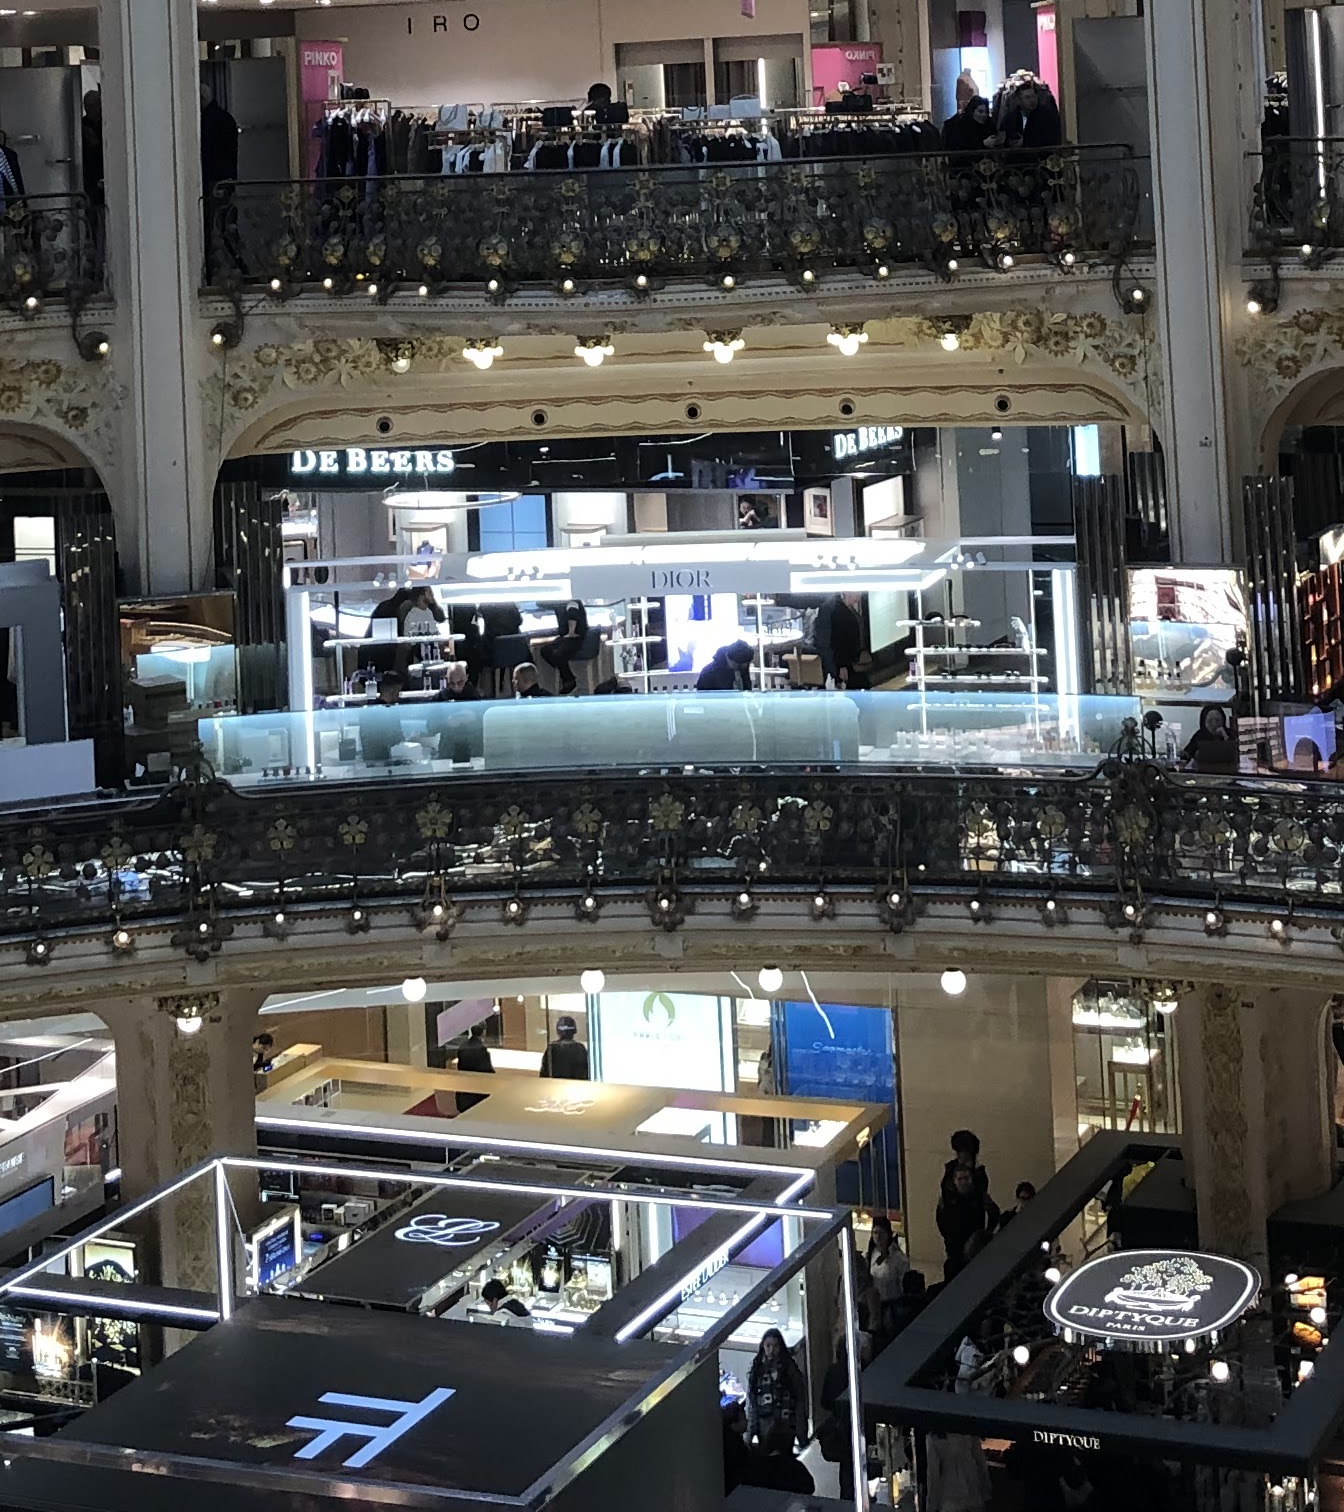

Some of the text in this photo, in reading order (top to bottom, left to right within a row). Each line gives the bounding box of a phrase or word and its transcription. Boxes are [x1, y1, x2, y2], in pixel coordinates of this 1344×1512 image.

[407, 13, 480, 35] IRO
[304, 51, 338, 66] PINKO
[834, 433, 858, 459] DE
[291, 447, 455, 473] DE BEERS
[651, 569, 713, 589] DIOR
[1067, 1304, 1200, 1328] DIPTYQUE
[1105, 1321, 1146, 1332] PARIS
[1032, 1430, 1101, 1450] DIPTYQUE
